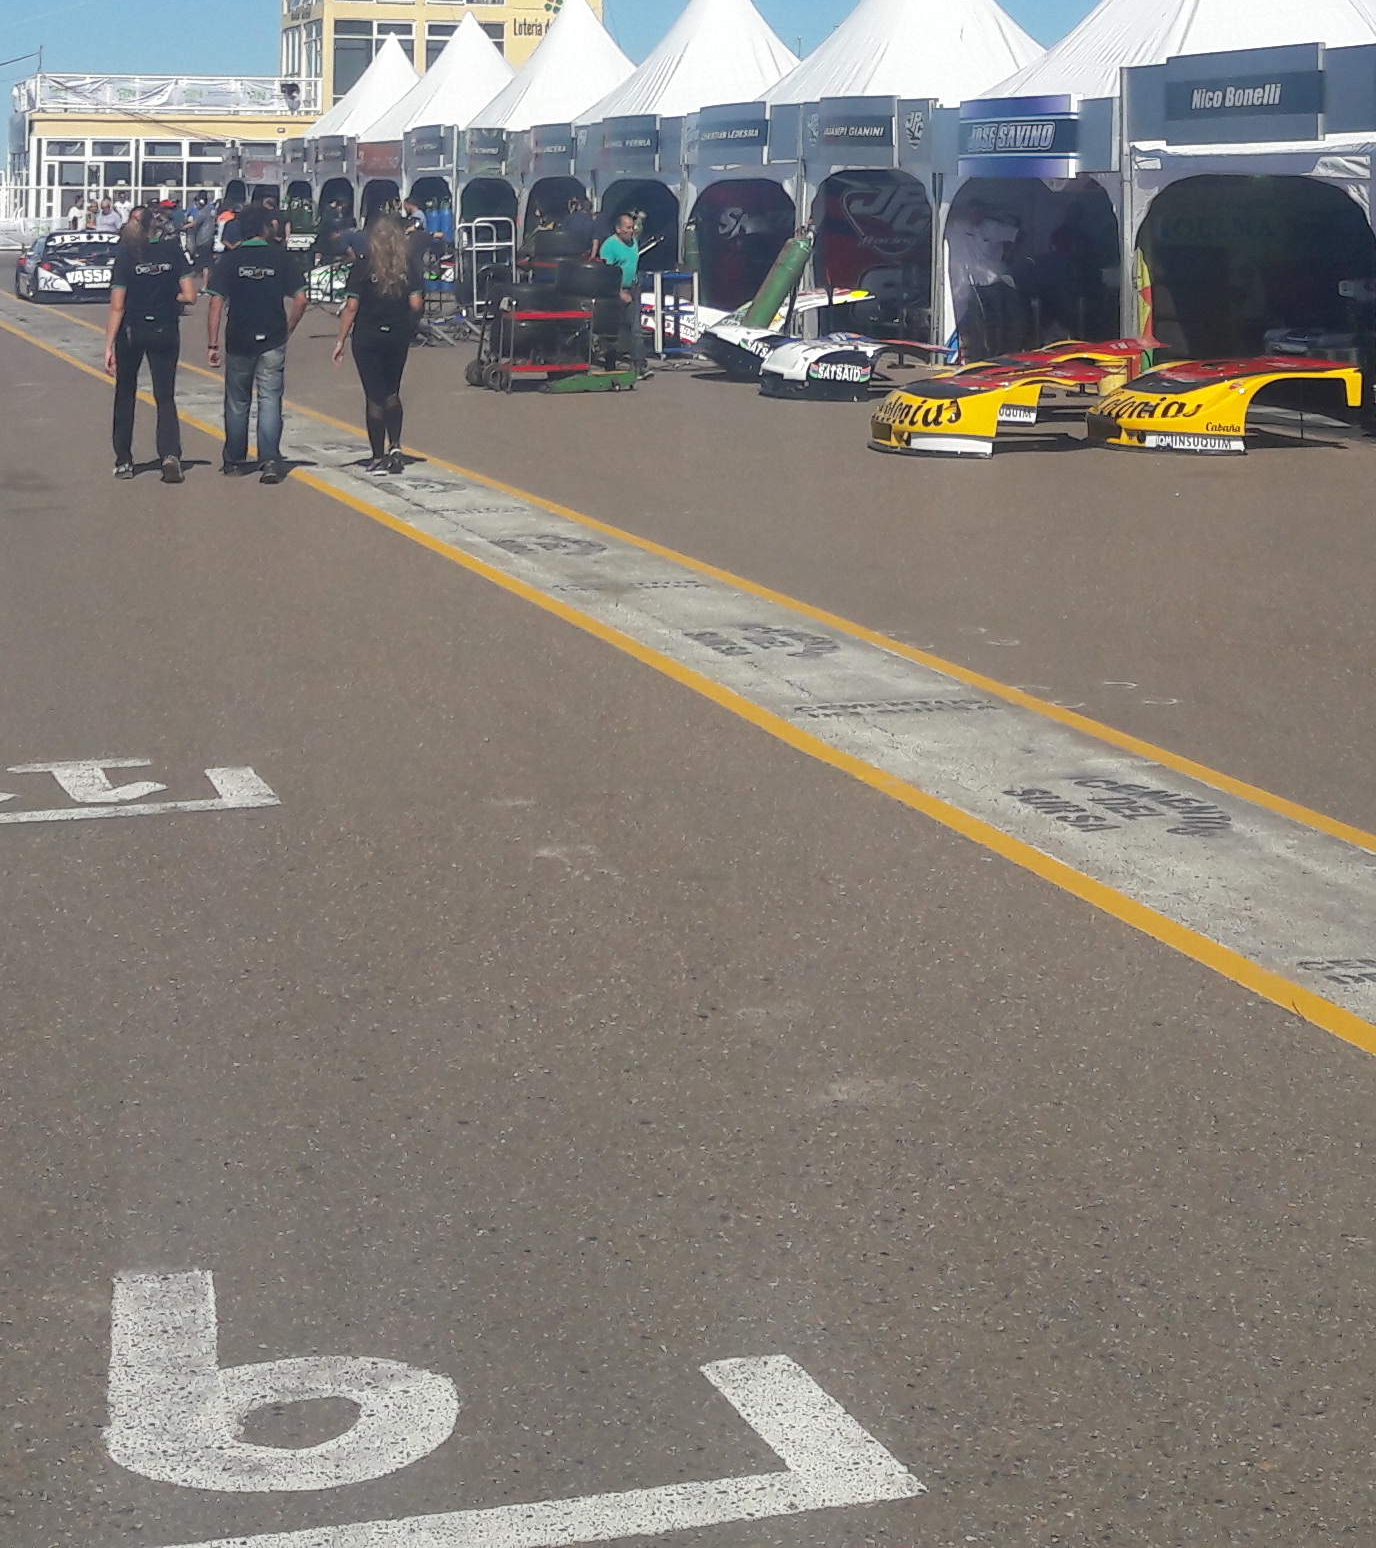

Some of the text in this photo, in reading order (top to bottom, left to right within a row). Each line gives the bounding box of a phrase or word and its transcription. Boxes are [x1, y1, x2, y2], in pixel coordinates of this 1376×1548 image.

[1190, 82, 1283, 110] Nico Bonelli
[848, 125, 885, 138] GIANINI
[967, 122, 1055, 152] JOSE SAVINO
